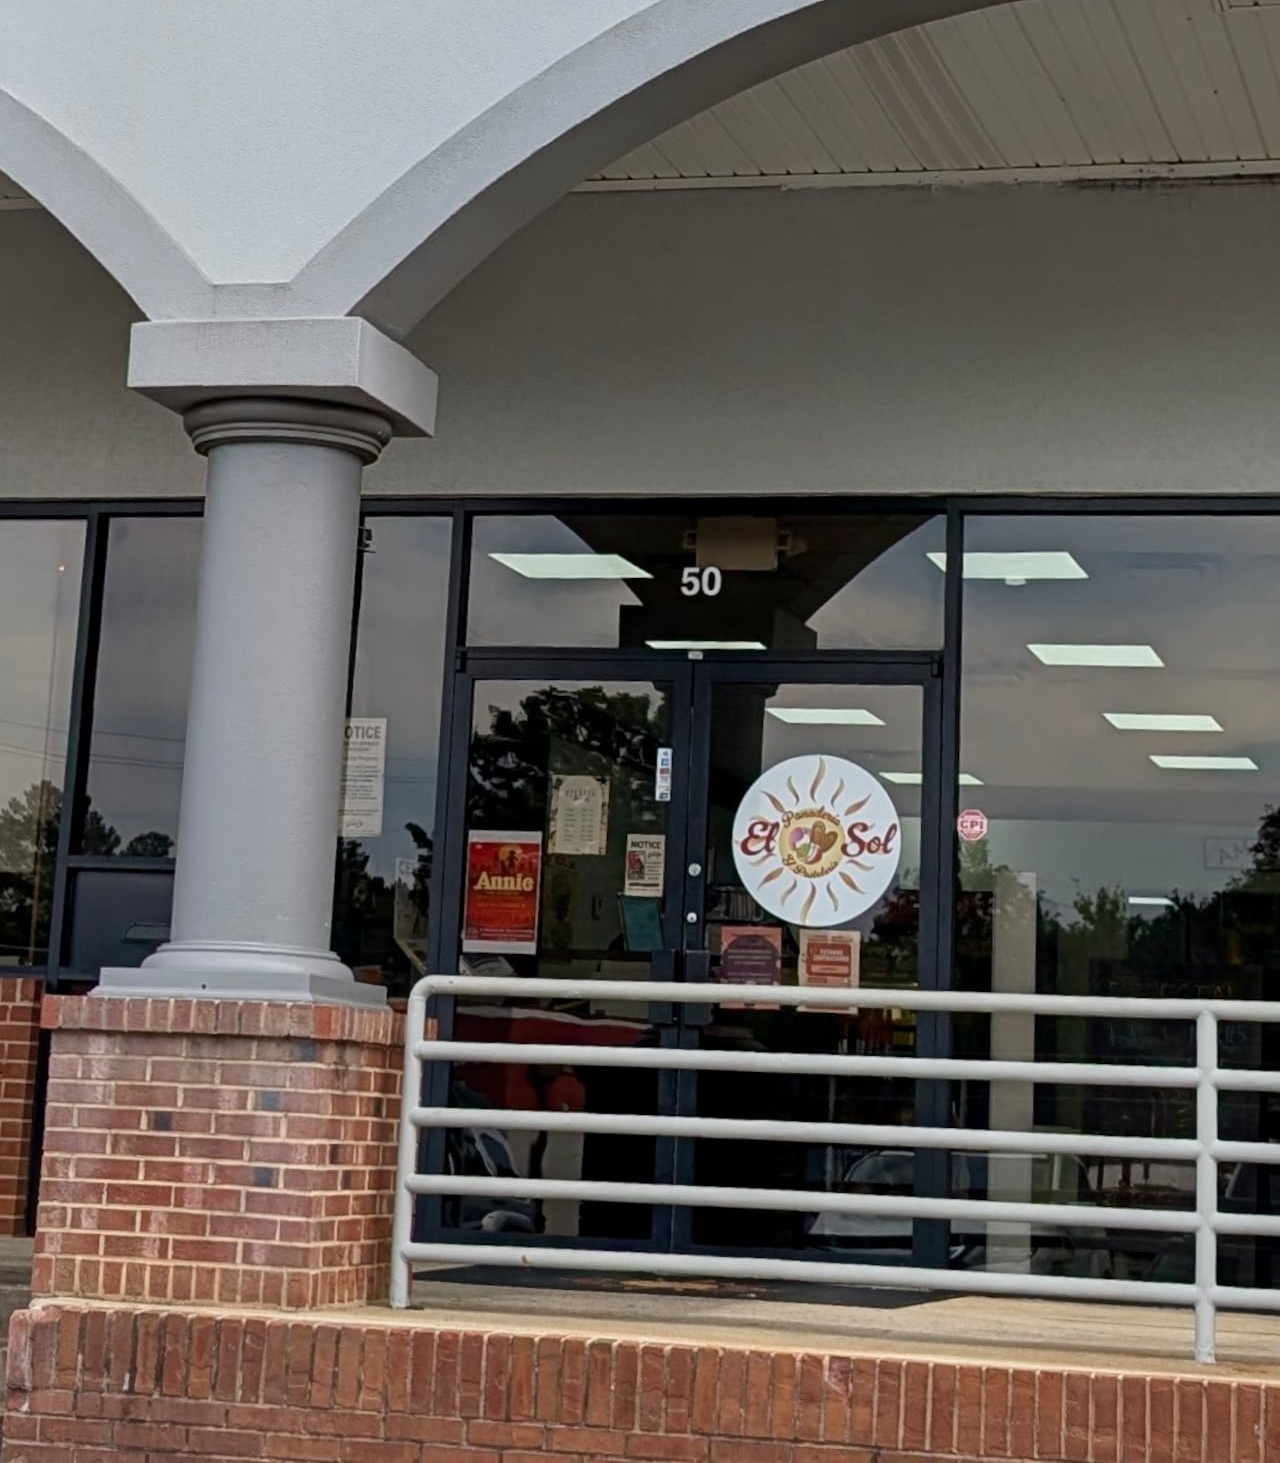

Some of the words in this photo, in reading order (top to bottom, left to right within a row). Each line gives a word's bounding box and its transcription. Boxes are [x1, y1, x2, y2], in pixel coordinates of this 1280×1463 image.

[680, 565, 722, 597] 50
[344, 725, 382, 739] OTICE
[960, 819, 984, 830] CPI
[631, 840, 661, 850] NOTICE
[740, 820, 780, 856] El
[840, 821, 898, 858] Sol
[473, 871, 535, 892] Annie
